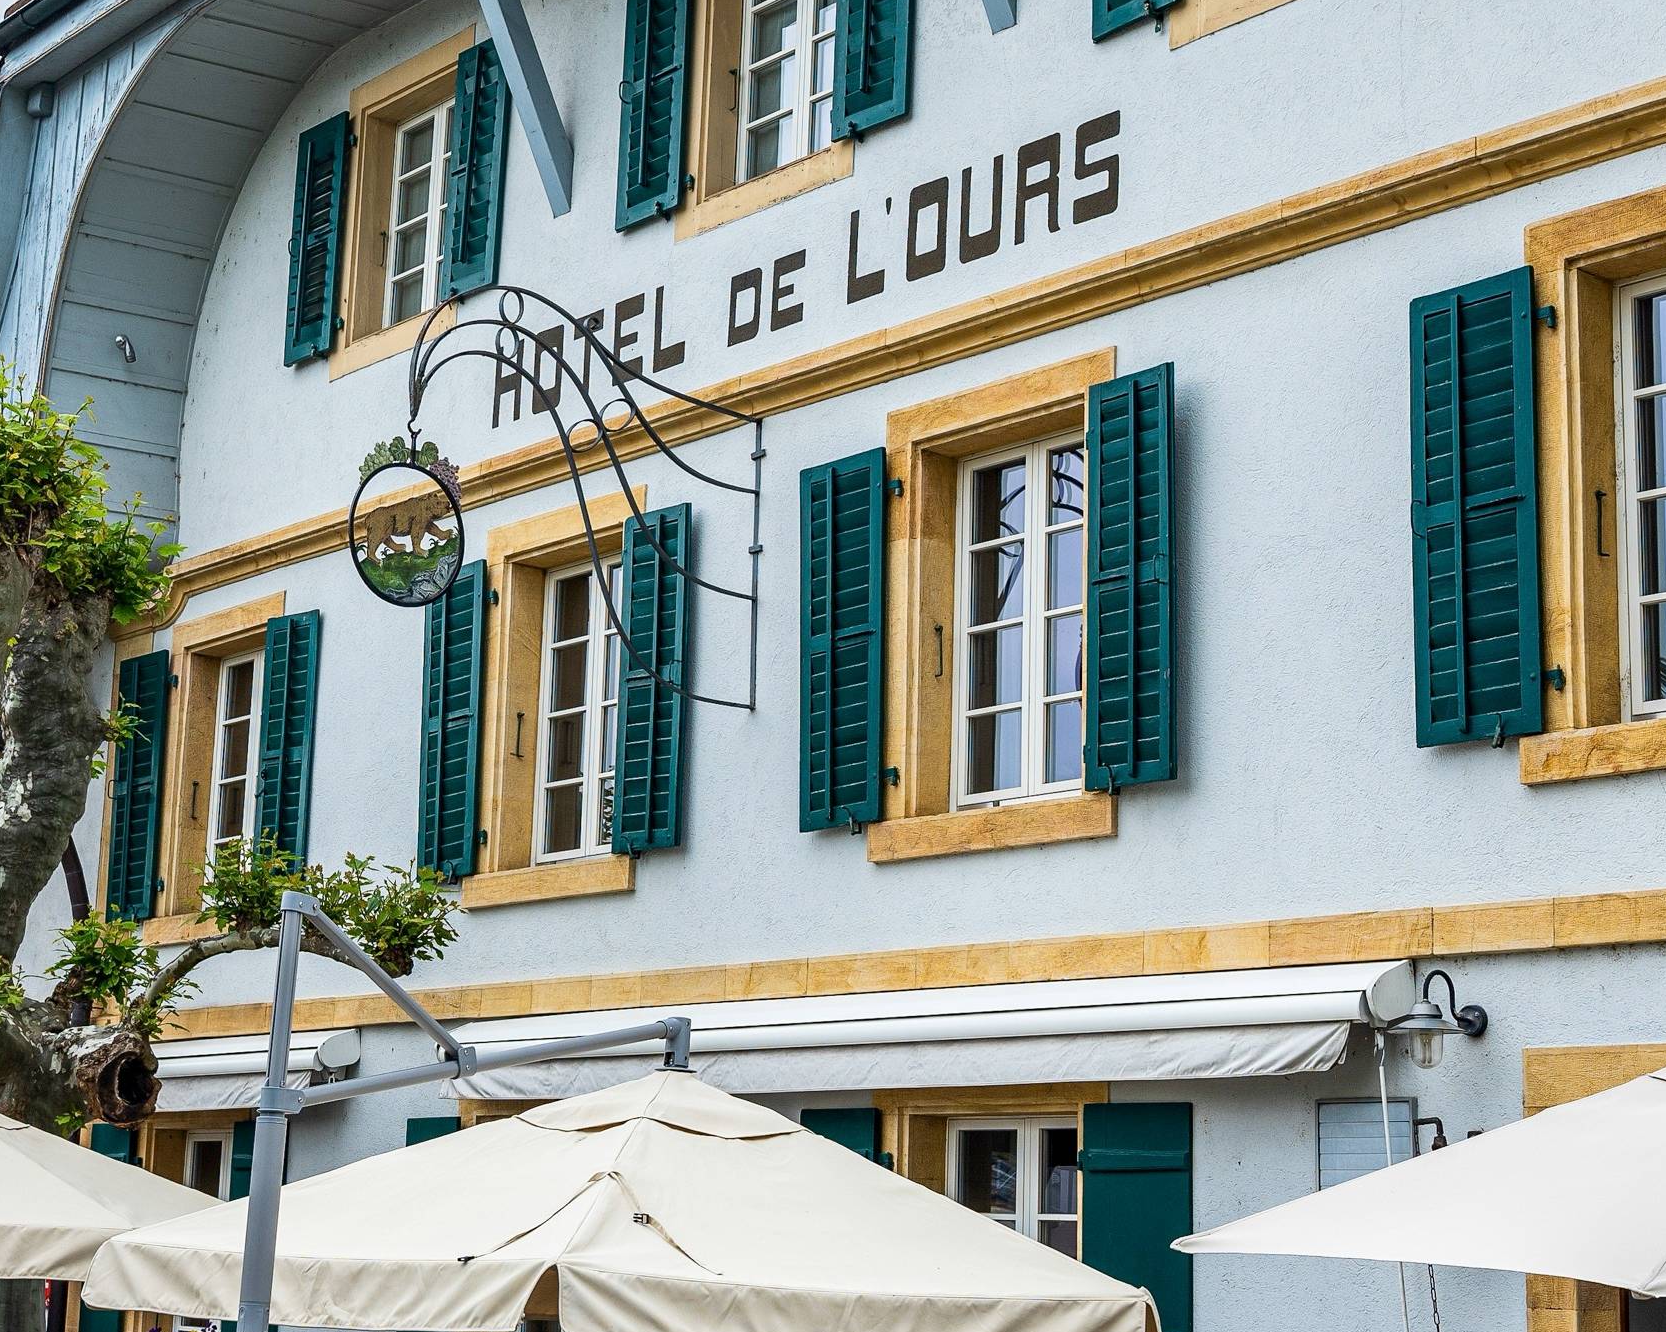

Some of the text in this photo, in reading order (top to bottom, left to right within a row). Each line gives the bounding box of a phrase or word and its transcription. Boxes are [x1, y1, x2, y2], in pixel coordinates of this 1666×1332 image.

[492, 110, 1121, 430] HOTEL DE L'OURS
